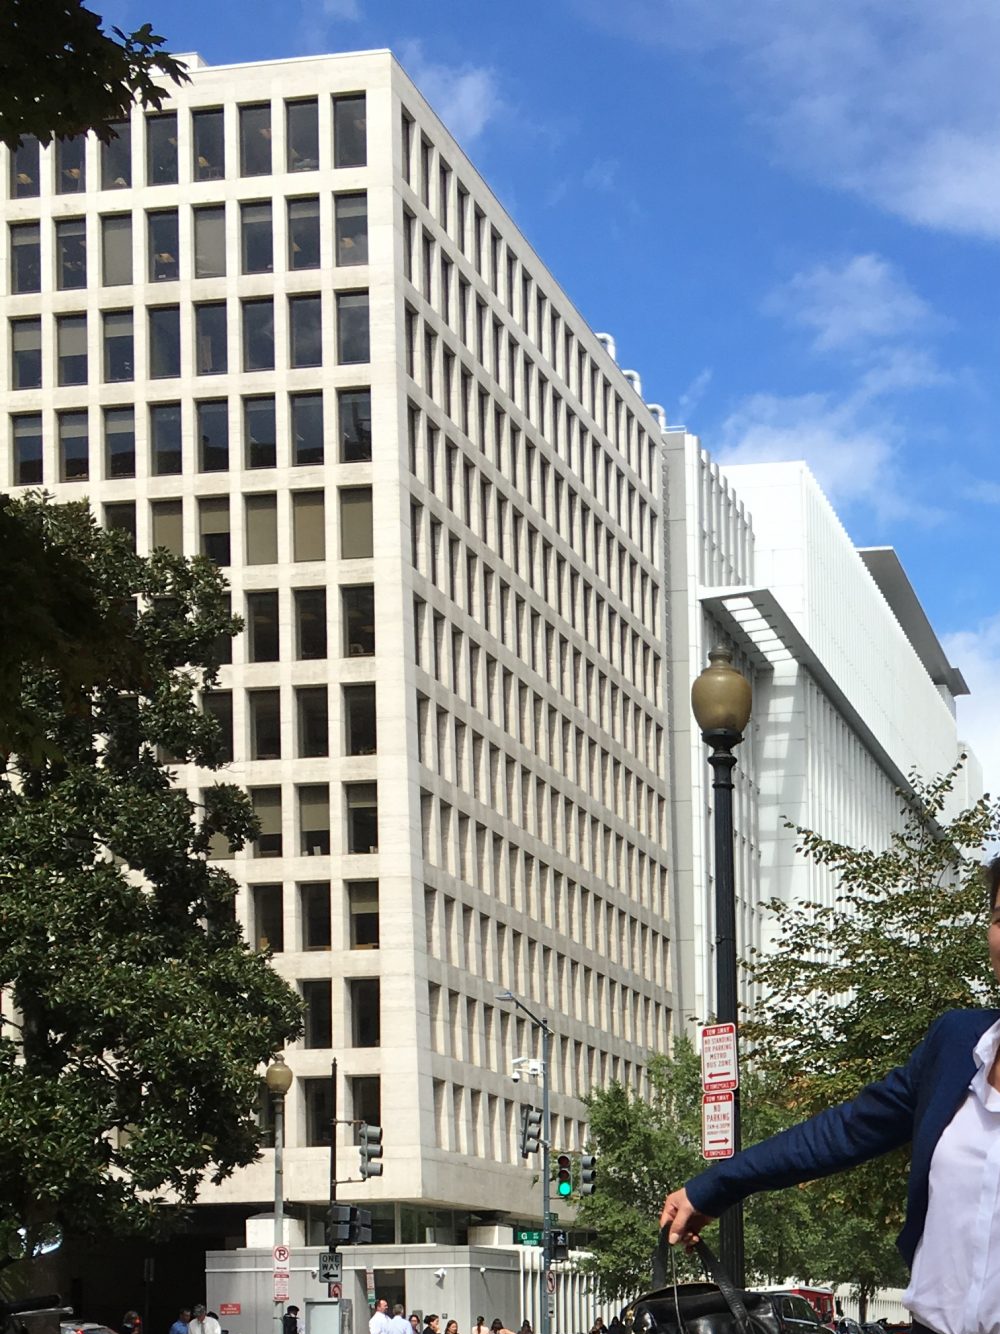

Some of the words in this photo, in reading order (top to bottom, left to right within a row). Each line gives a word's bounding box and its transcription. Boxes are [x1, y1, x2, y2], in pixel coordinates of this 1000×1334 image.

[710, 1052, 727, 1060] METRO
[713, 1104, 721, 1112] NO
[706, 1113, 730, 1122] PARKING
[521, 1232, 528, 1240] G
[322, 1255, 340, 1263] ONE
[322, 1263, 340, 1271] WAY
